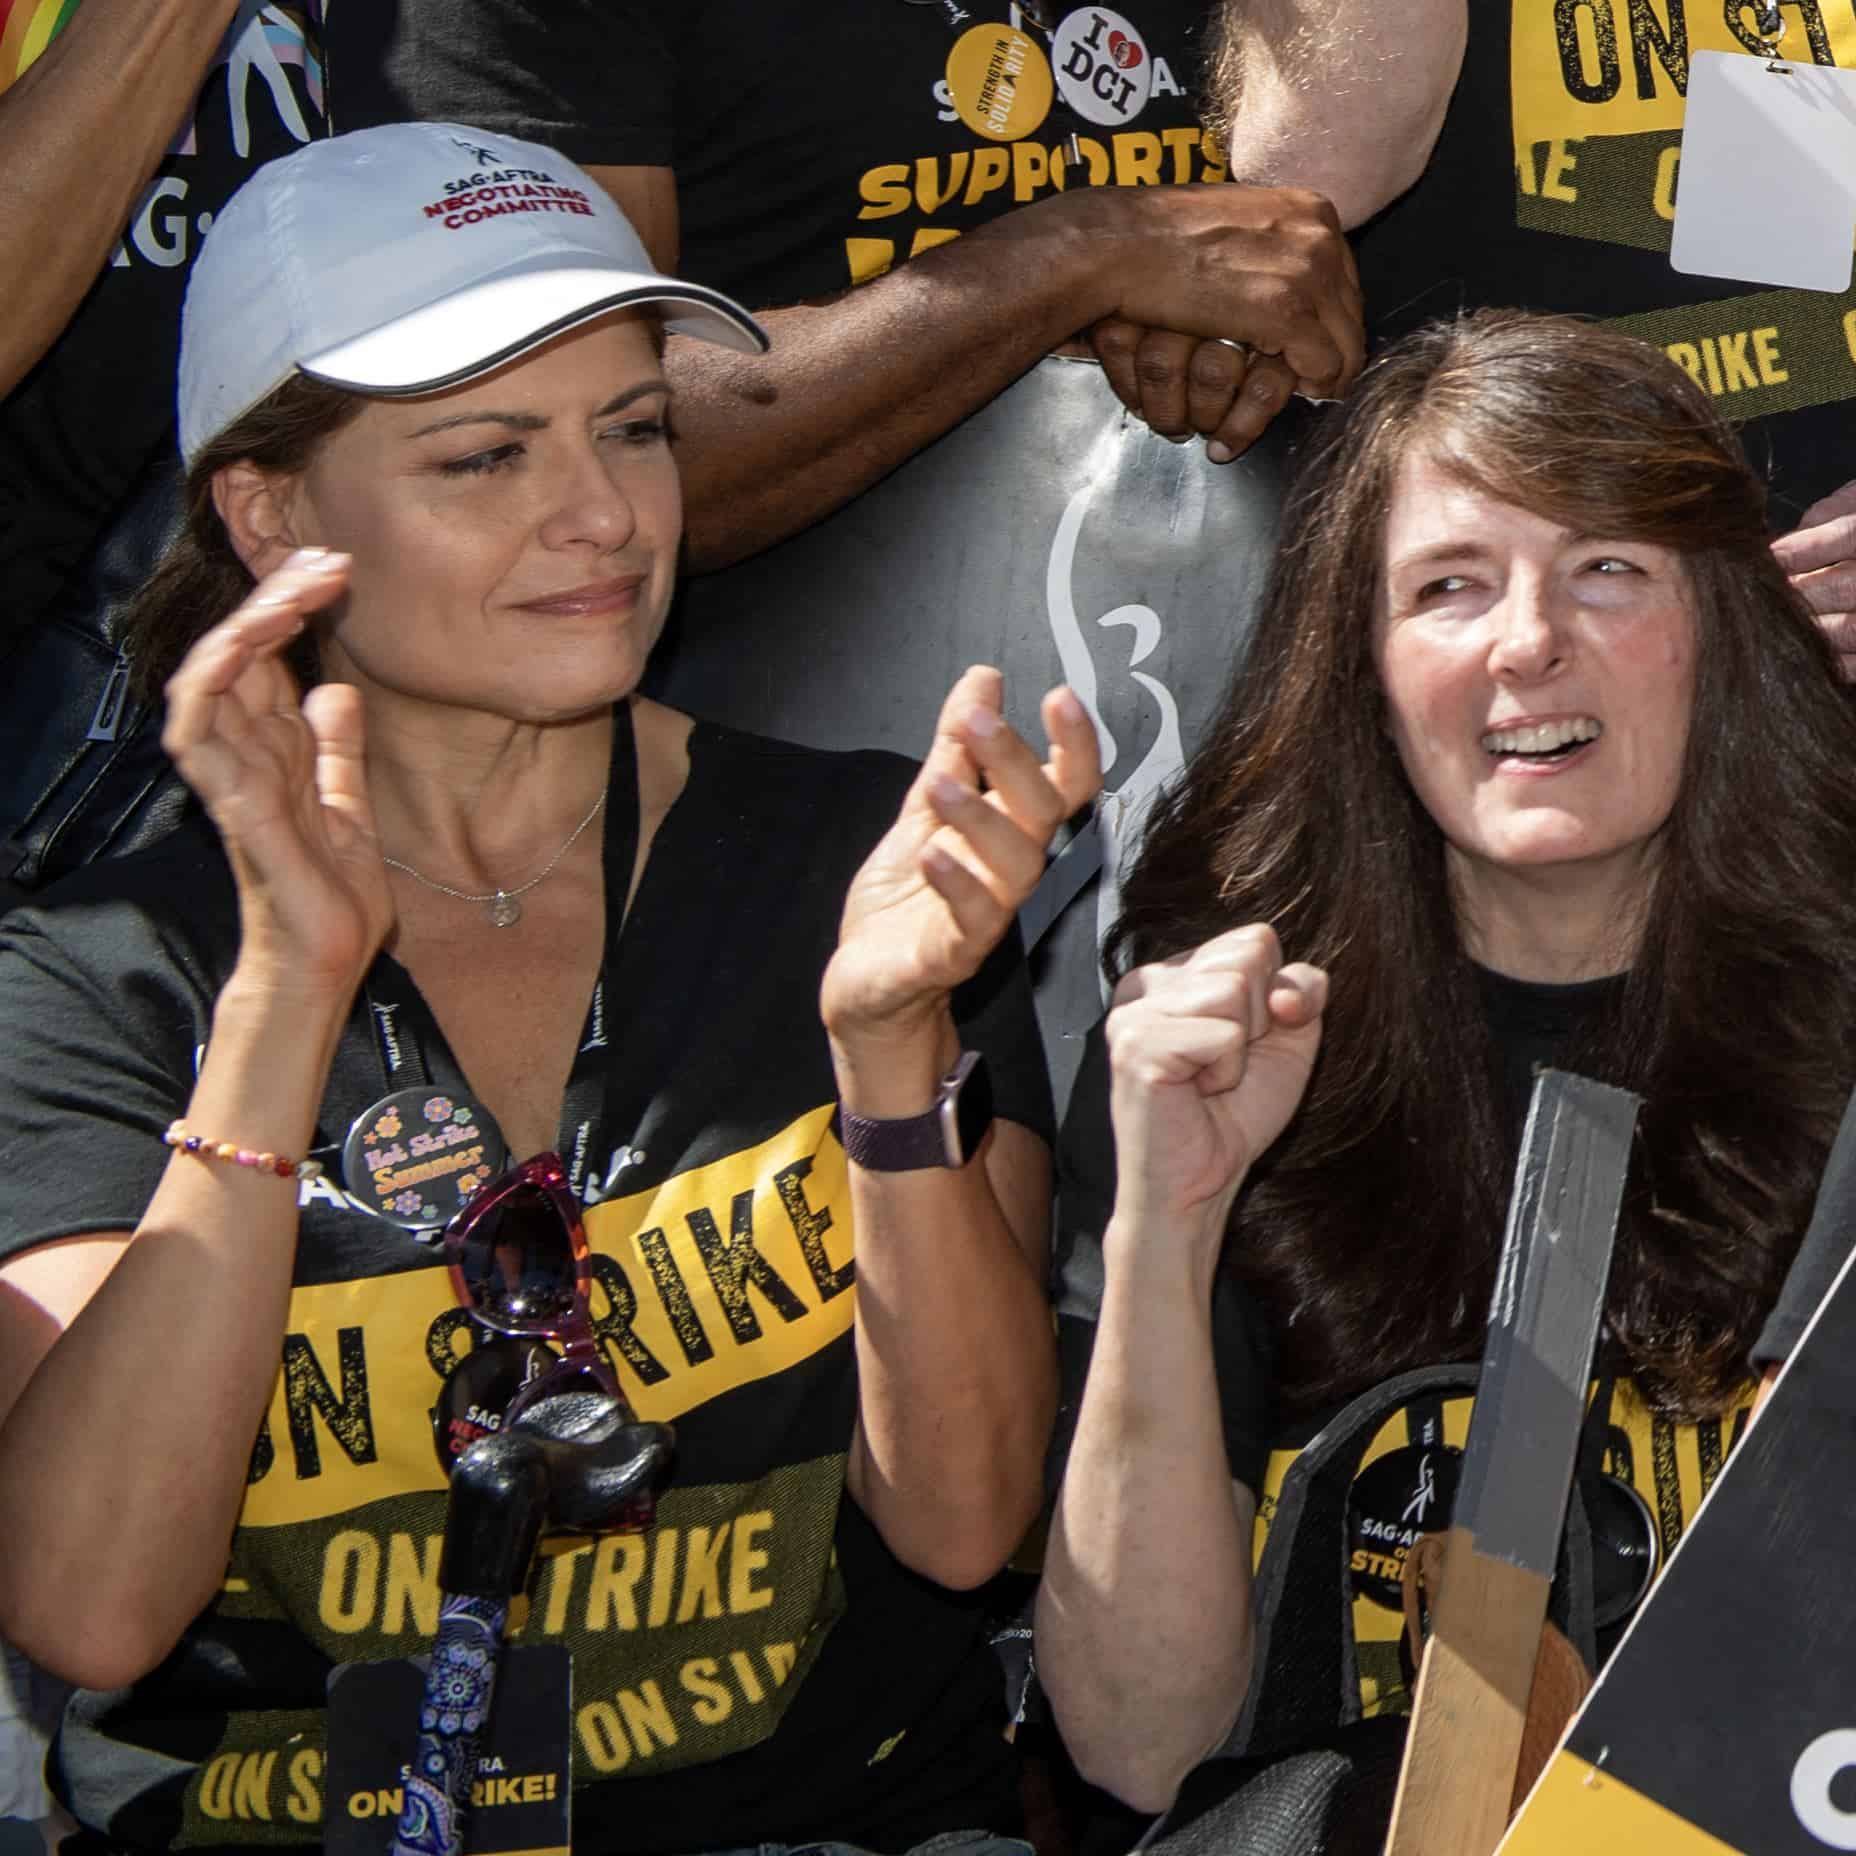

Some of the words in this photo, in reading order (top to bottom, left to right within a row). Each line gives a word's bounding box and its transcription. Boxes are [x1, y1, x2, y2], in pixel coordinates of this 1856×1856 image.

[1083, 13, 1109, 52] I
[976, 52, 1004, 115] STRENGTH
[996, 38, 1010, 53] IN
[985, 35, 1030, 134] SOLIDARITY
[1061, 40, 1138, 116] DCI
[422, 184, 591, 219] NEGOTIATING
[857, 128, 1230, 221] SUPPORTS
[443, 199, 596, 230] COMMITTEE
[364, 1144, 409, 1173] Hot
[373, 1145, 485, 1195] Summer
[319, 1527, 446, 1636] ON
[576, 1680, 679, 1773] ON
[200, 1752, 279, 1822] ON
[348, 1787, 404, 1819] ON
